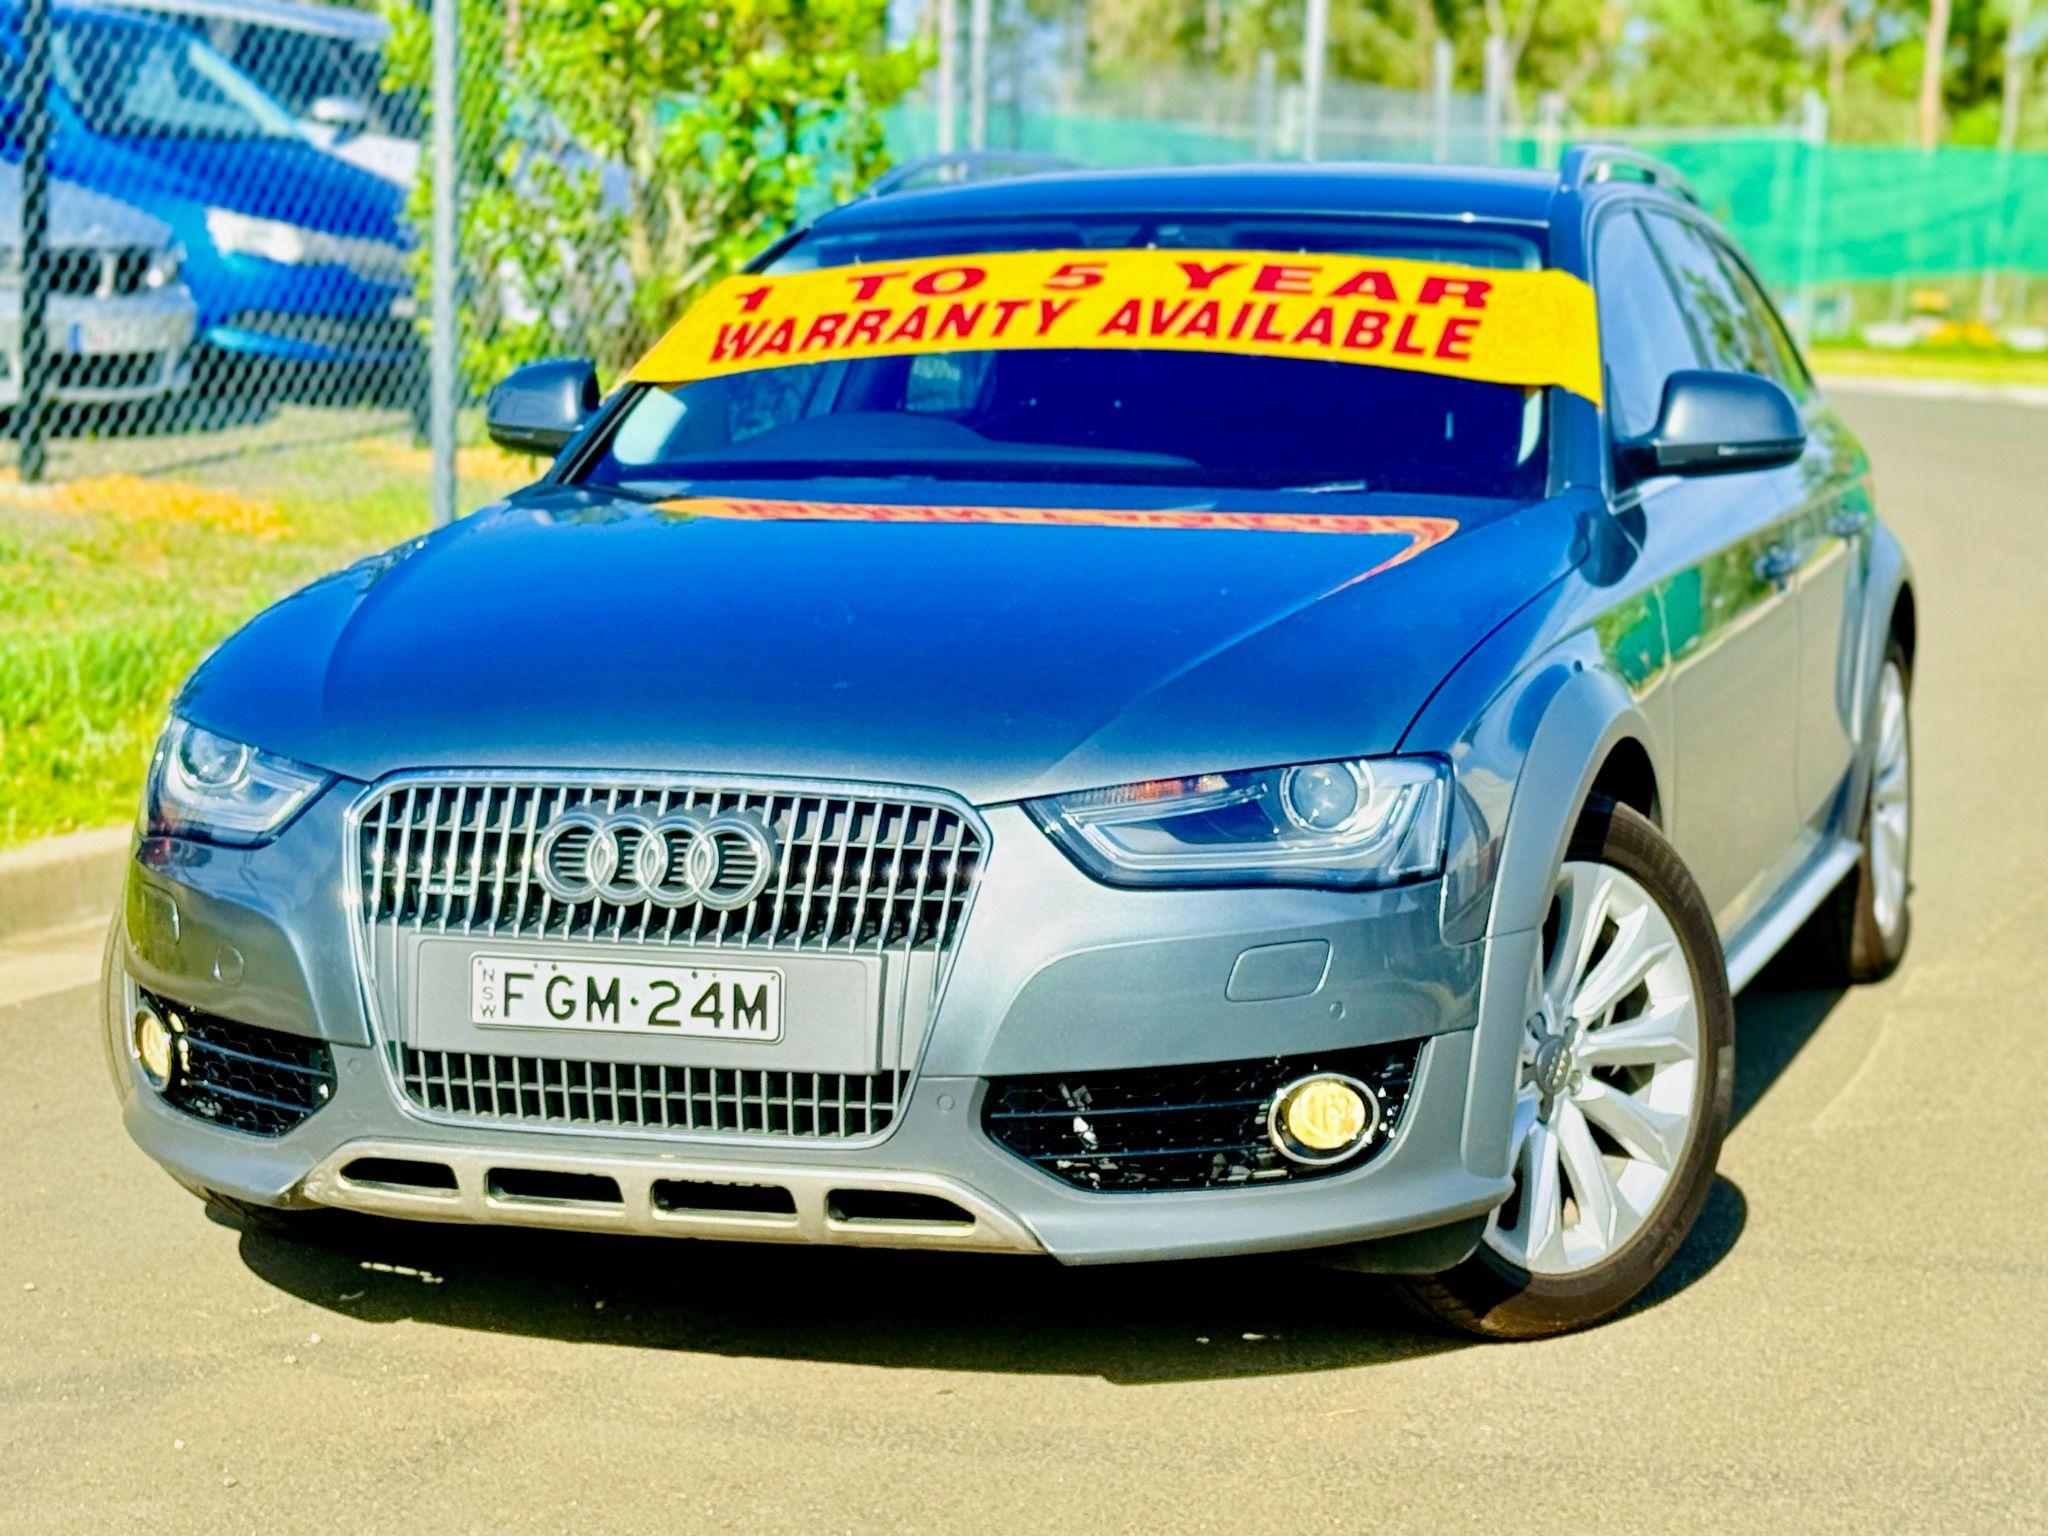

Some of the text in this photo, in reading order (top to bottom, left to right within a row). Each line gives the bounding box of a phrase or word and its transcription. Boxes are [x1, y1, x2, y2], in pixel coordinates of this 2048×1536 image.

[735, 262, 1494, 314] 1 TO 5 YEAR
[708, 298, 1483, 363] WARRANTY AVAILABLE
[480, 967, 497, 1019] NSW
